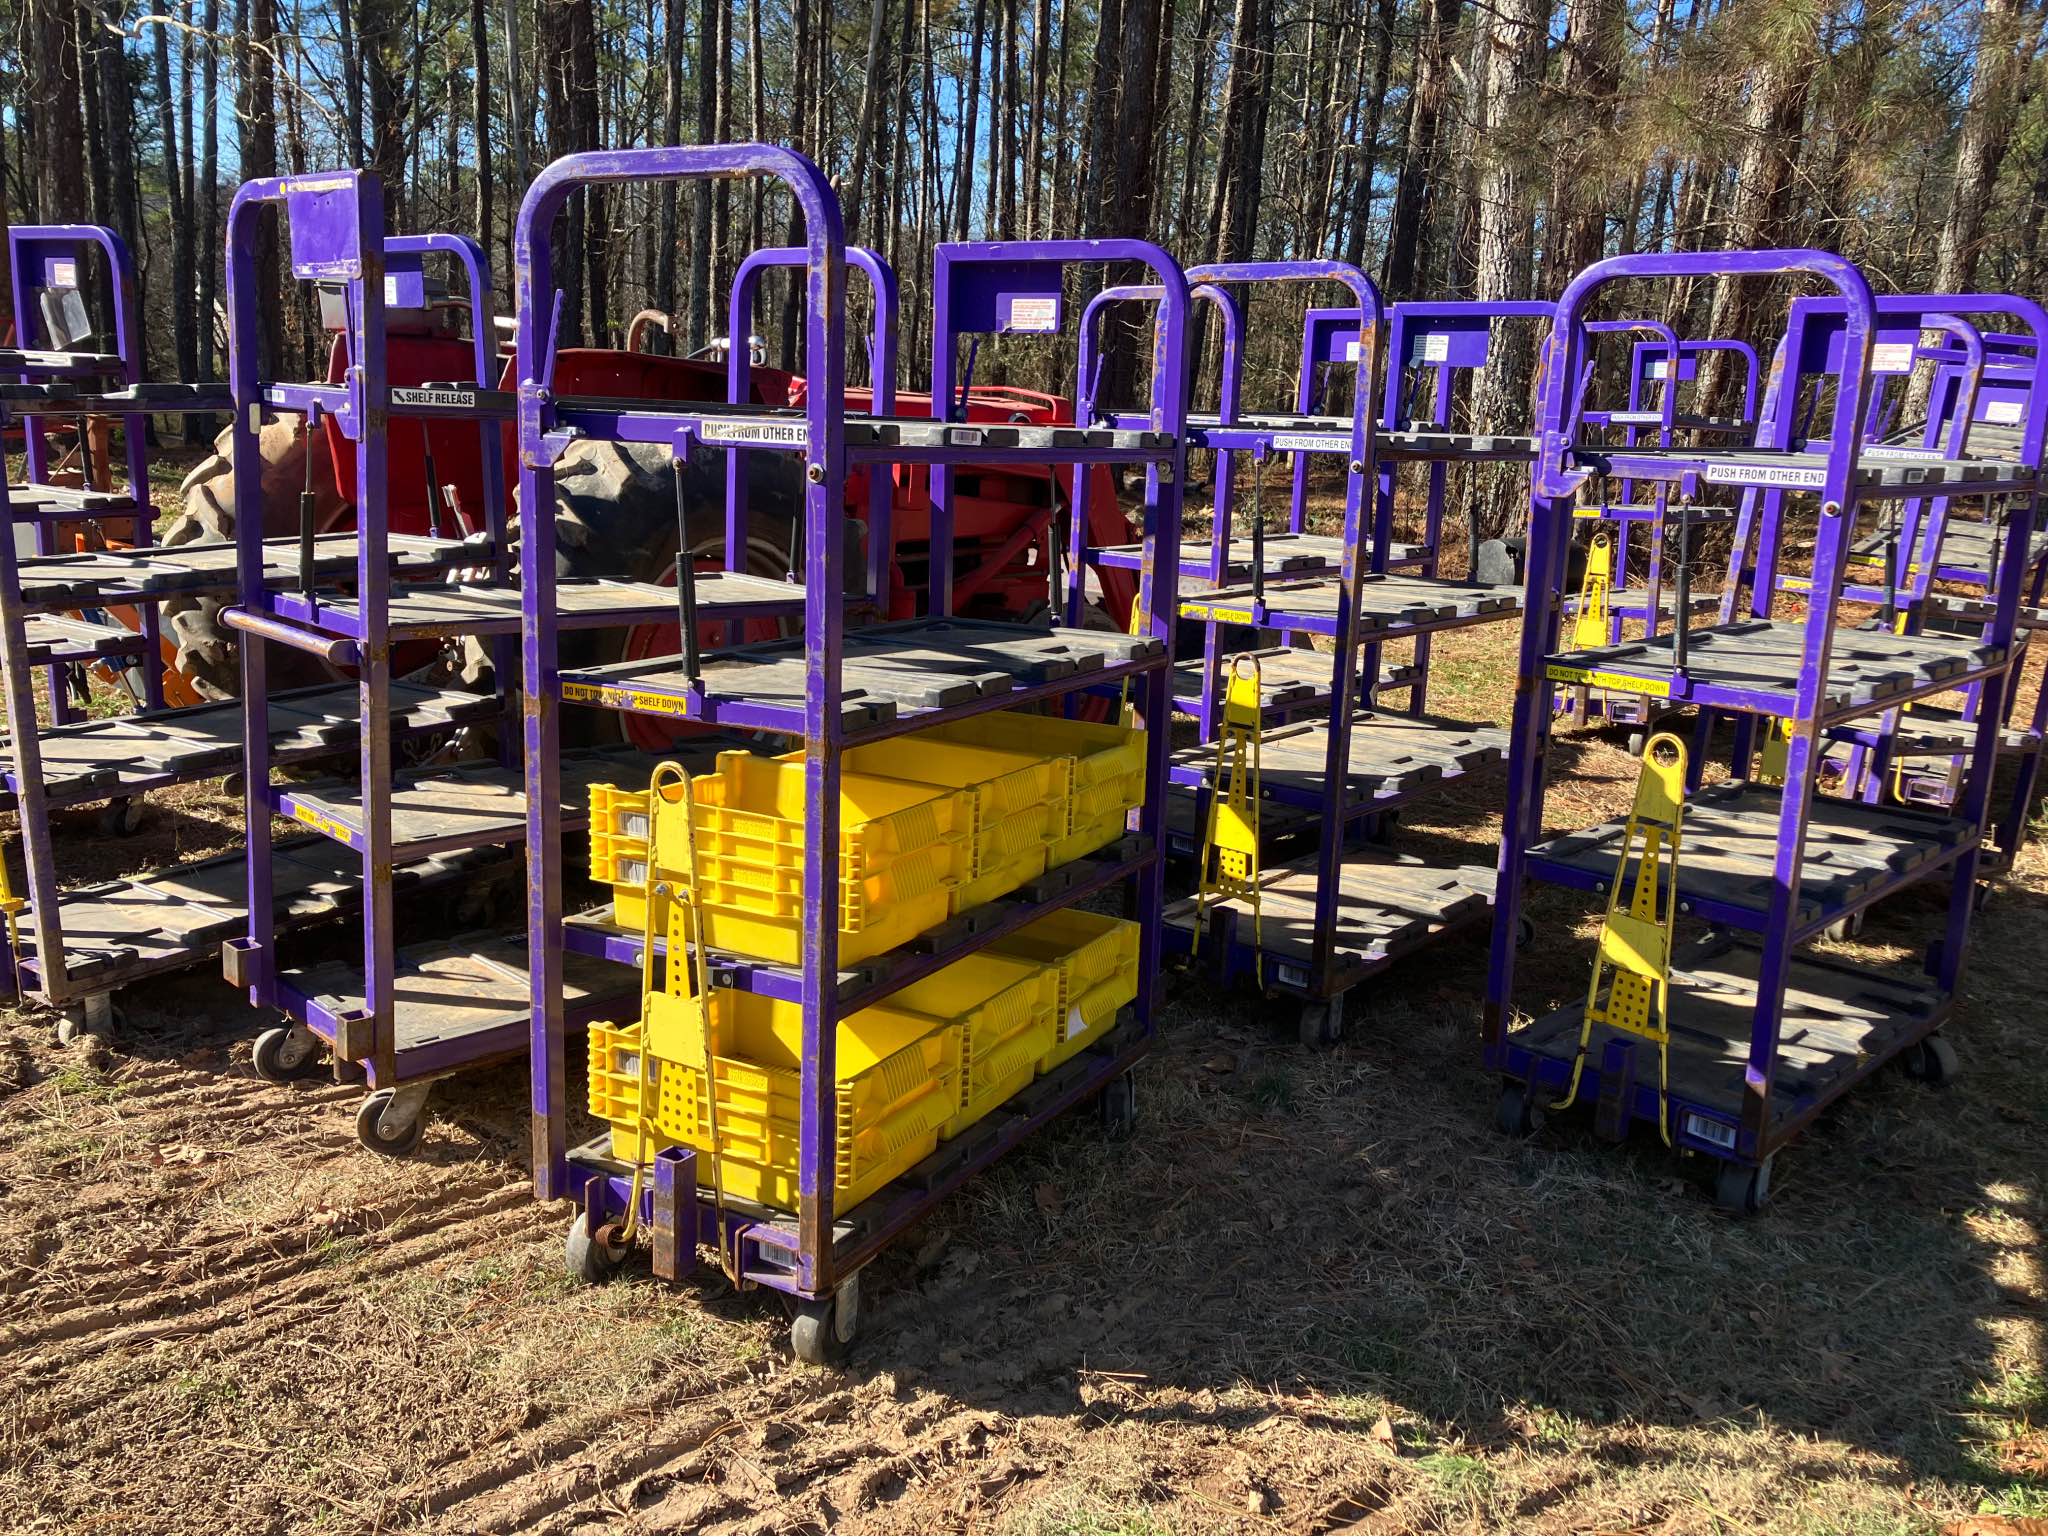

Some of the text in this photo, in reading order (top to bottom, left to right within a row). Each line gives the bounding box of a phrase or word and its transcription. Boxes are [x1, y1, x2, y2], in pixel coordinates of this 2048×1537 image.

[406, 392, 473, 405] SHELF RELEASE
[762, 426, 794, 441] OTHER
[796, 428, 808, 442] EN
[1275, 437, 1293, 448] PUSH
[1294, 438, 1313, 448] FROM
[1315, 439, 1339, 449] OTHER
[1710, 467, 1825, 484] PUSH FROM OTHER END
[1549, 667, 1559, 676] DO
[1560, 669, 1573, 678] NOT
[1645, 681, 1666, 693] DOWN
[564, 685, 574, 696] DO
[575, 687, 588, 698] NOT
[639, 696, 661, 707] SHELF
[662, 698, 684, 711] DOWN
